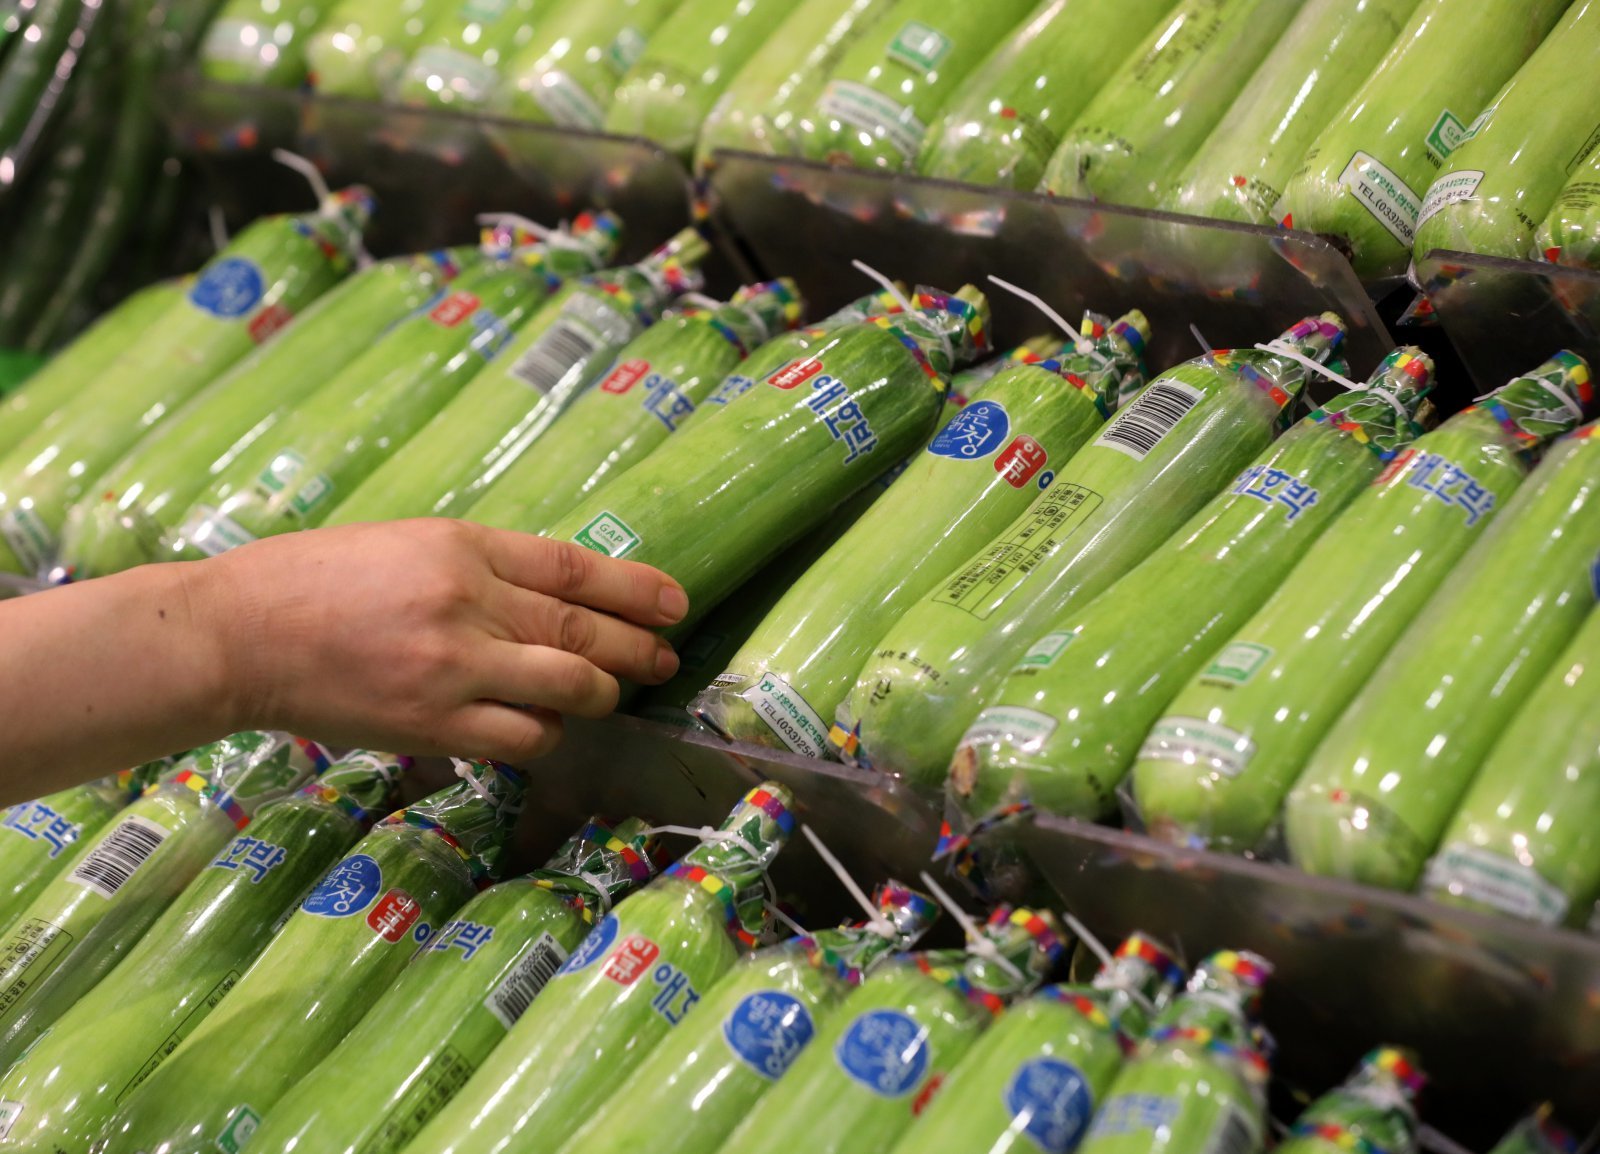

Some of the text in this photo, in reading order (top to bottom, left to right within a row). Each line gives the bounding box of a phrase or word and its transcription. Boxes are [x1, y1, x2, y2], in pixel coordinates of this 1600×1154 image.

[808, 376, 878, 464] 애호박
[1409, 454, 1495, 525] 애호박
[599, 522, 625, 546] GAP
